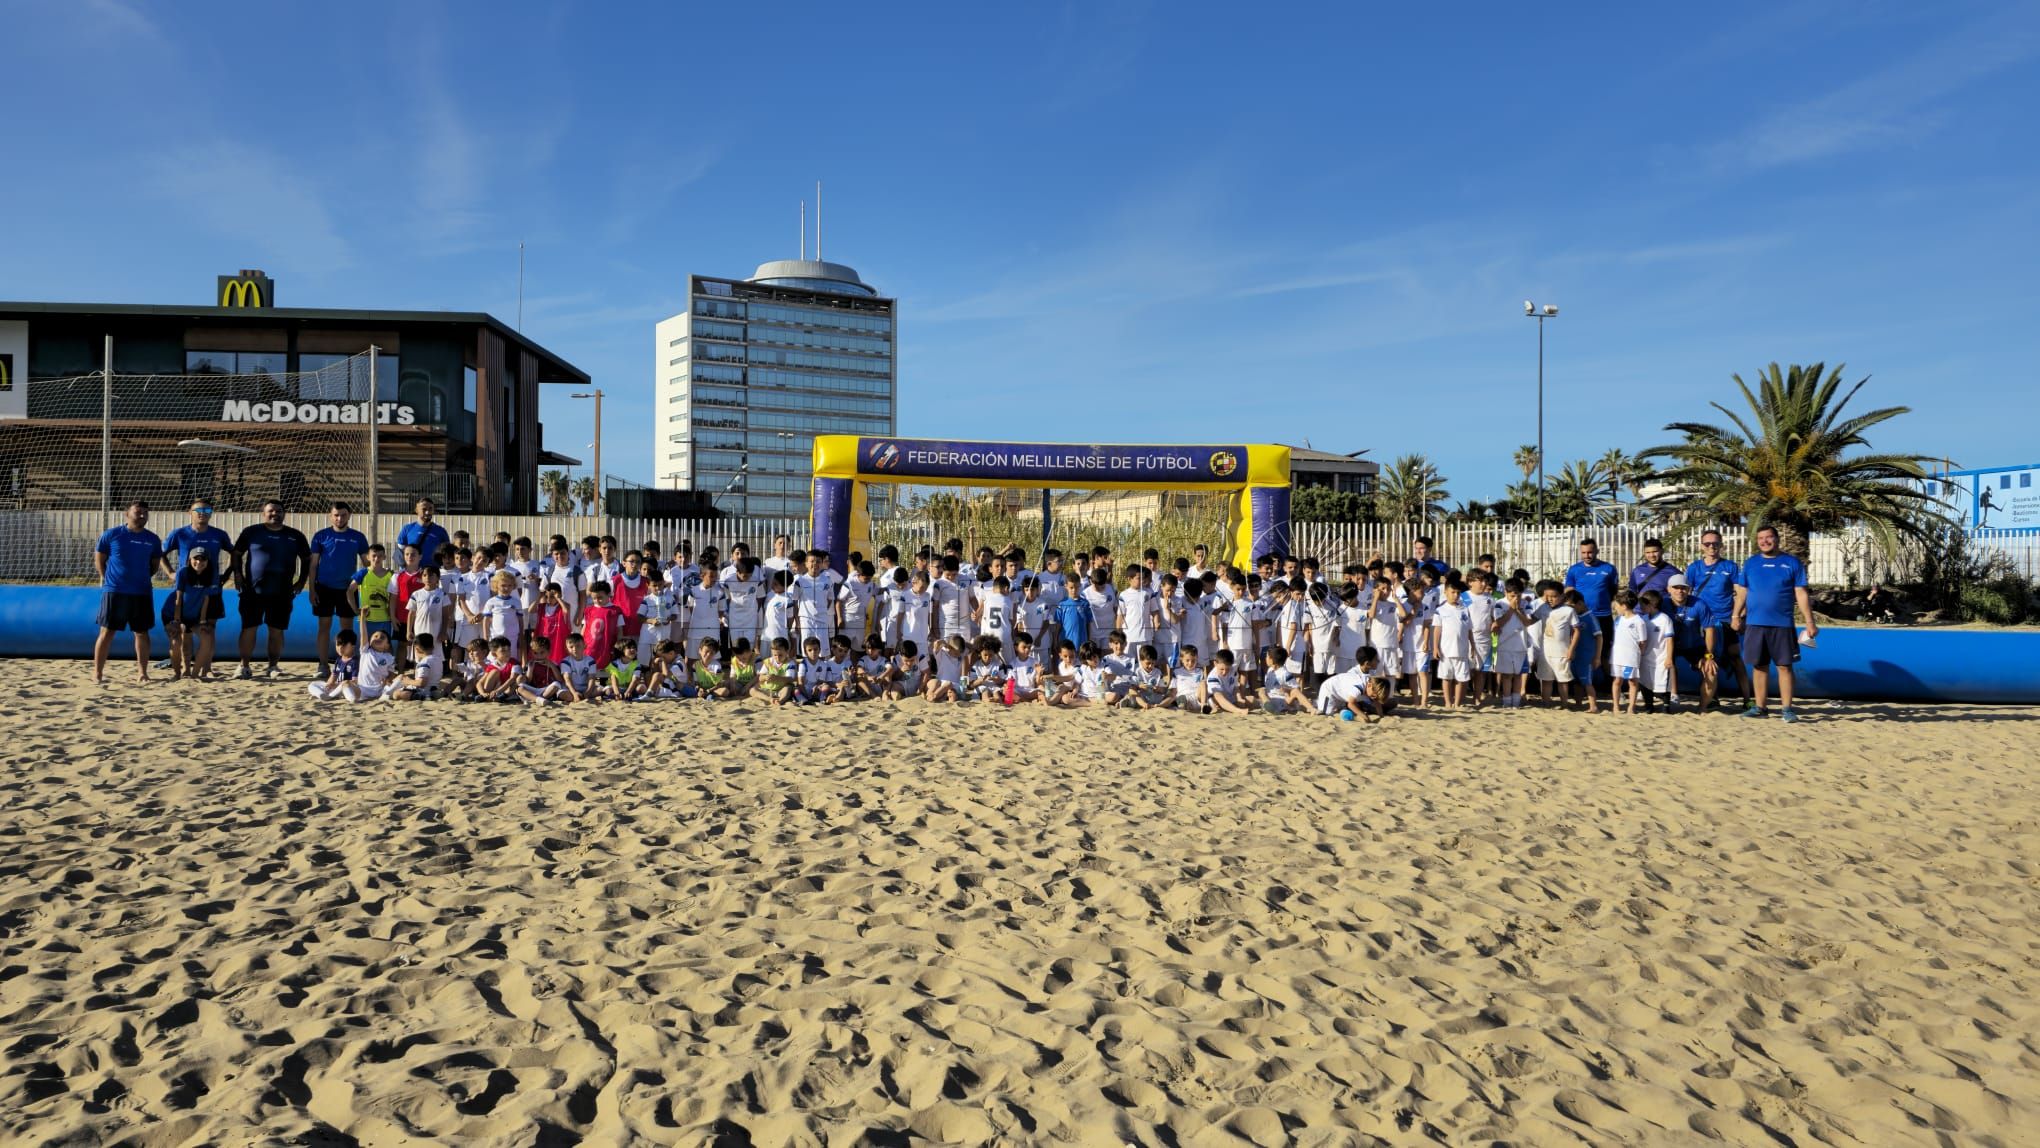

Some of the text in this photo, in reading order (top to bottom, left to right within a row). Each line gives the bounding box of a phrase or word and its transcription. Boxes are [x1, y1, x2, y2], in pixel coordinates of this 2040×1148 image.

[221, 399, 415, 425] McDonald's
[908, 450, 1198, 470] FEDERACIÓN MELILLENSE DE FÚTBOL
[990, 607, 1002, 629] 5
